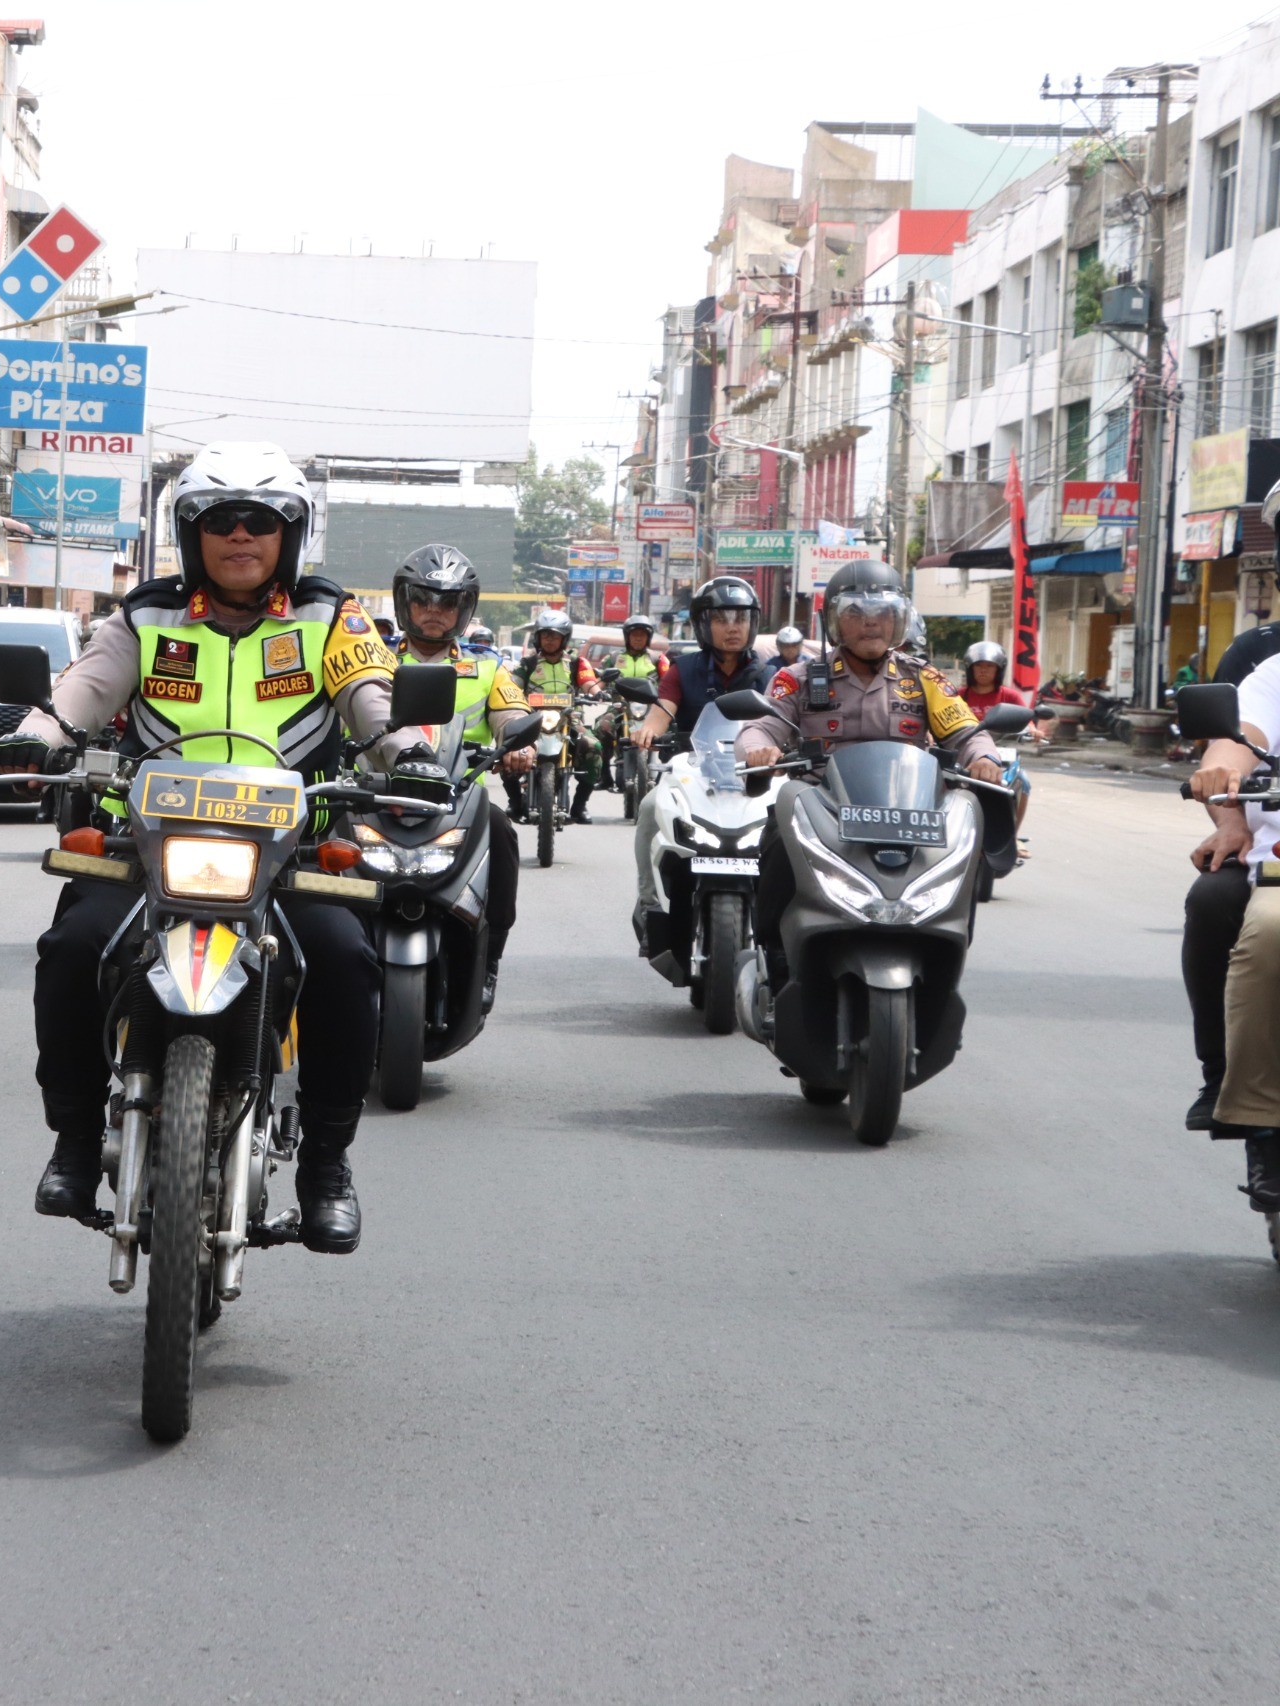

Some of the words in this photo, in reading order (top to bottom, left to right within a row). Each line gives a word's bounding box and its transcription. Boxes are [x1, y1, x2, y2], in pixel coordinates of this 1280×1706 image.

[10, 388, 104, 423] Pizza
[643, 508, 691, 517] Alfamart
[38, 521, 72, 534] SINR
[74, 522, 115, 536] UTAMA
[719, 536, 748, 548] ADIL
[753, 536, 786, 548] JAYA
[819, 548, 871, 560] Natama
[328, 649, 355, 679] KA
[147, 680, 197, 700] YOGEN
[258, 676, 309, 697] KAPOLRES
